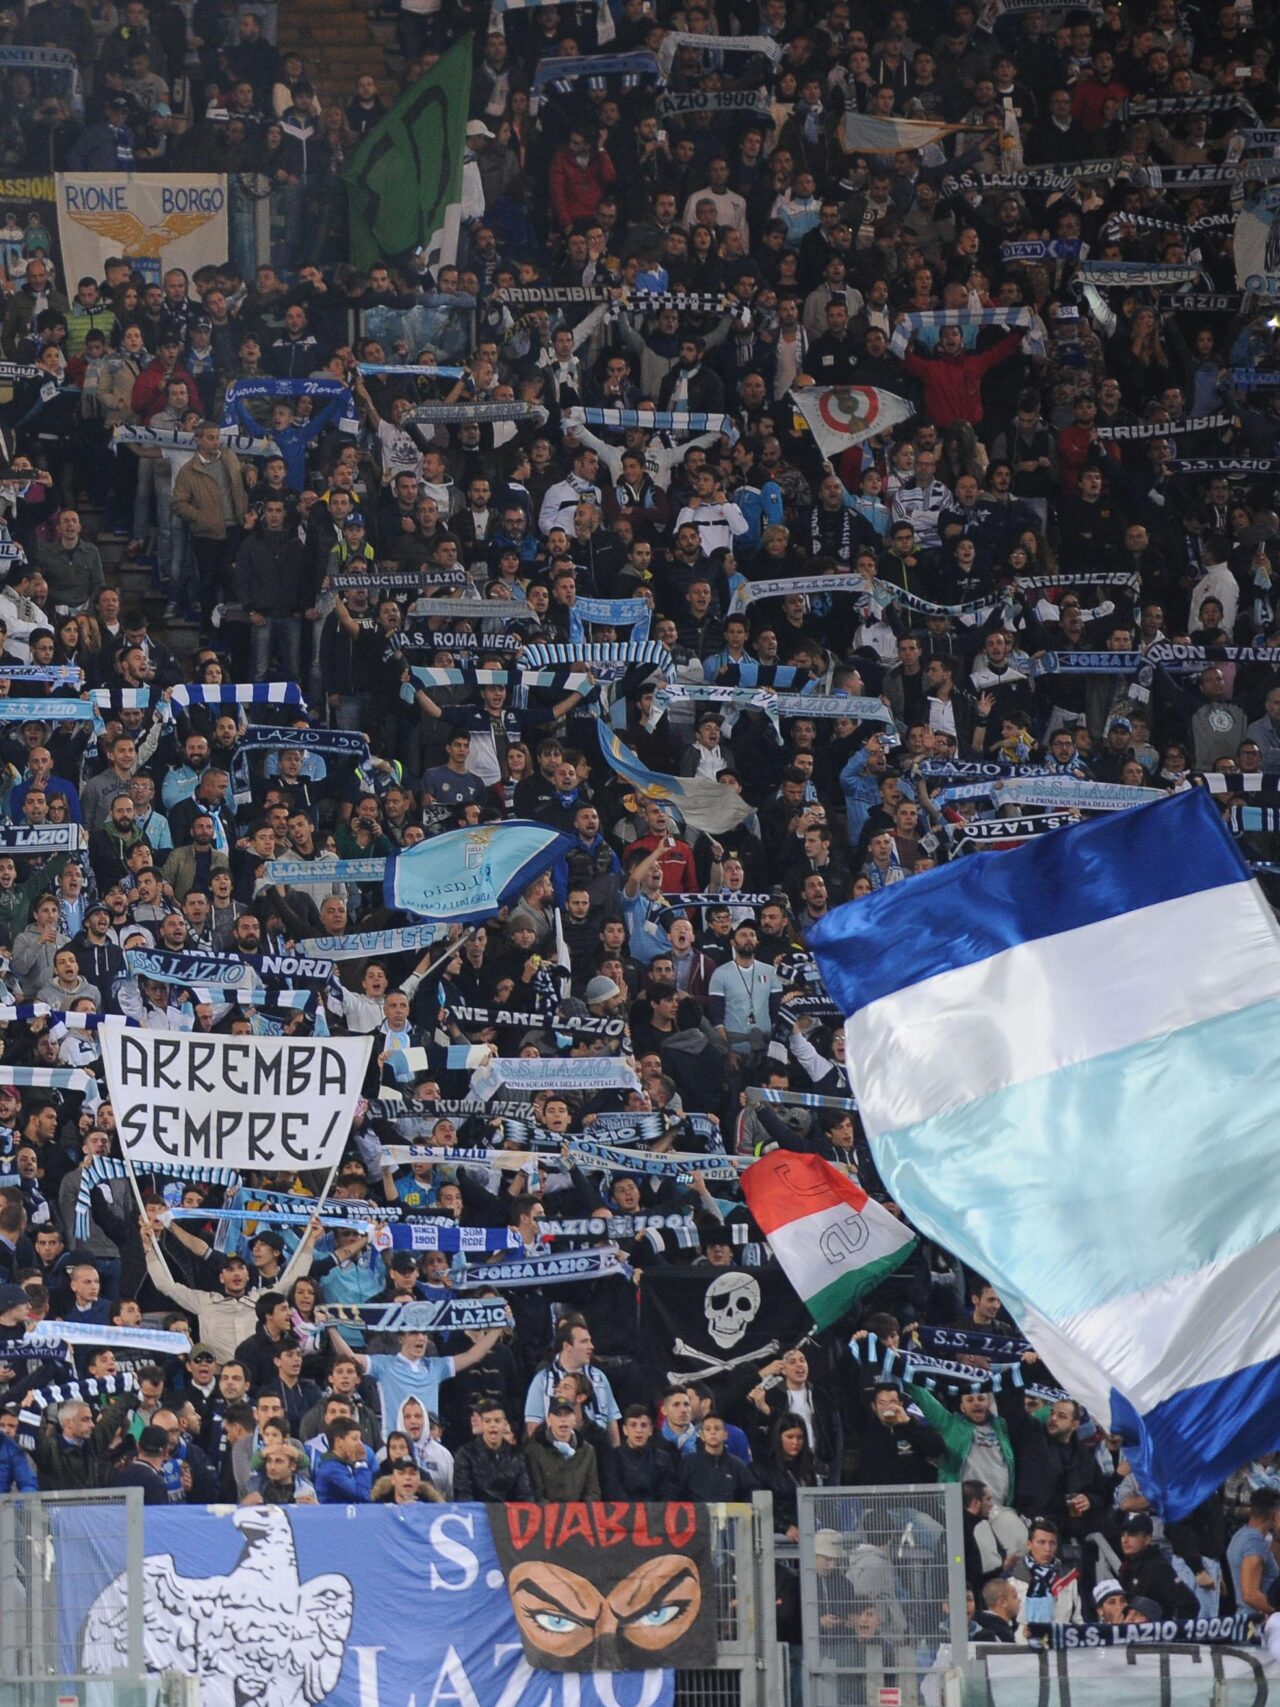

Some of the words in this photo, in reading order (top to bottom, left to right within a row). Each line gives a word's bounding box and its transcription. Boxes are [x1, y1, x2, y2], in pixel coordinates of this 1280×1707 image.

[663, 93, 708, 112] AZIO
[713, 93, 756, 108] 1900
[947, 175, 977, 191] S.S.
[980, 173, 1028, 187] LAZIO
[65, 186, 128, 211] RIONE
[161, 187, 224, 213] BORGO
[1169, 297, 1228, 309] LAZIO
[224, 383, 267, 403] Curva
[302, 379, 346, 394] Nord
[1181, 459, 1215, 472] S.S.
[1219, 459, 1272, 471] LAZIO
[333, 576, 419, 590] IRRIDUCIBILI
[427, 572, 466, 586] LAZIO
[399, 632, 426, 648] A.S.
[433, 632, 478, 648] ROMA
[1070, 654, 1121, 667] FORZA
[37, 702, 78, 717] LAZIO
[15, 829, 69, 847] LAZIO
[964, 818, 1035, 840] LAZIO
[720, 891, 770, 905] LAZIO
[315, 929, 394, 951] LAZIO
[133, 951, 166, 974] S.S.
[165, 957, 246, 985] LAZIO
[261, 954, 333, 979] NORD
[452, 1004, 489, 1022] WE
[495, 1010, 545, 1028] ARE
[551, 1014, 625, 1036] LAZIO
[119, 1034, 347, 1096] ARREMBA
[500, 1058, 537, 1079] S.S.
[540, 1057, 613, 1079] LAZIO
[397, 1099, 430, 1114] A.S.
[435, 1098, 486, 1114] ROMA
[490, 1101, 537, 1121] MER
[120, 1103, 342, 1163] SEMPRE!
[570, 1126, 637, 1144] LAZIO
[409, 1146, 439, 1157] S.S.
[443, 1147, 488, 1160] LAZIO
[292, 1203, 342, 1216] MOLTI
[347, 1204, 403, 1217] NEMICI
[413, 1226, 437, 1235] SINCE
[414, 1235, 437, 1246] 1900
[478, 1263, 534, 1281] FORZA
[537, 1258, 589, 1277] LAZIO
[450, 1308, 506, 1325] LAZIO
[933, 1329, 969, 1348] S.S.
[981, 1335, 1034, 1355] LAZ
[503, 1500, 696, 1550] DIABLO
[1064, 1626, 1107, 1649] S.S.
[1112, 1620, 1177, 1645] LAZIO
[1183, 1616, 1235, 1641] 1900
